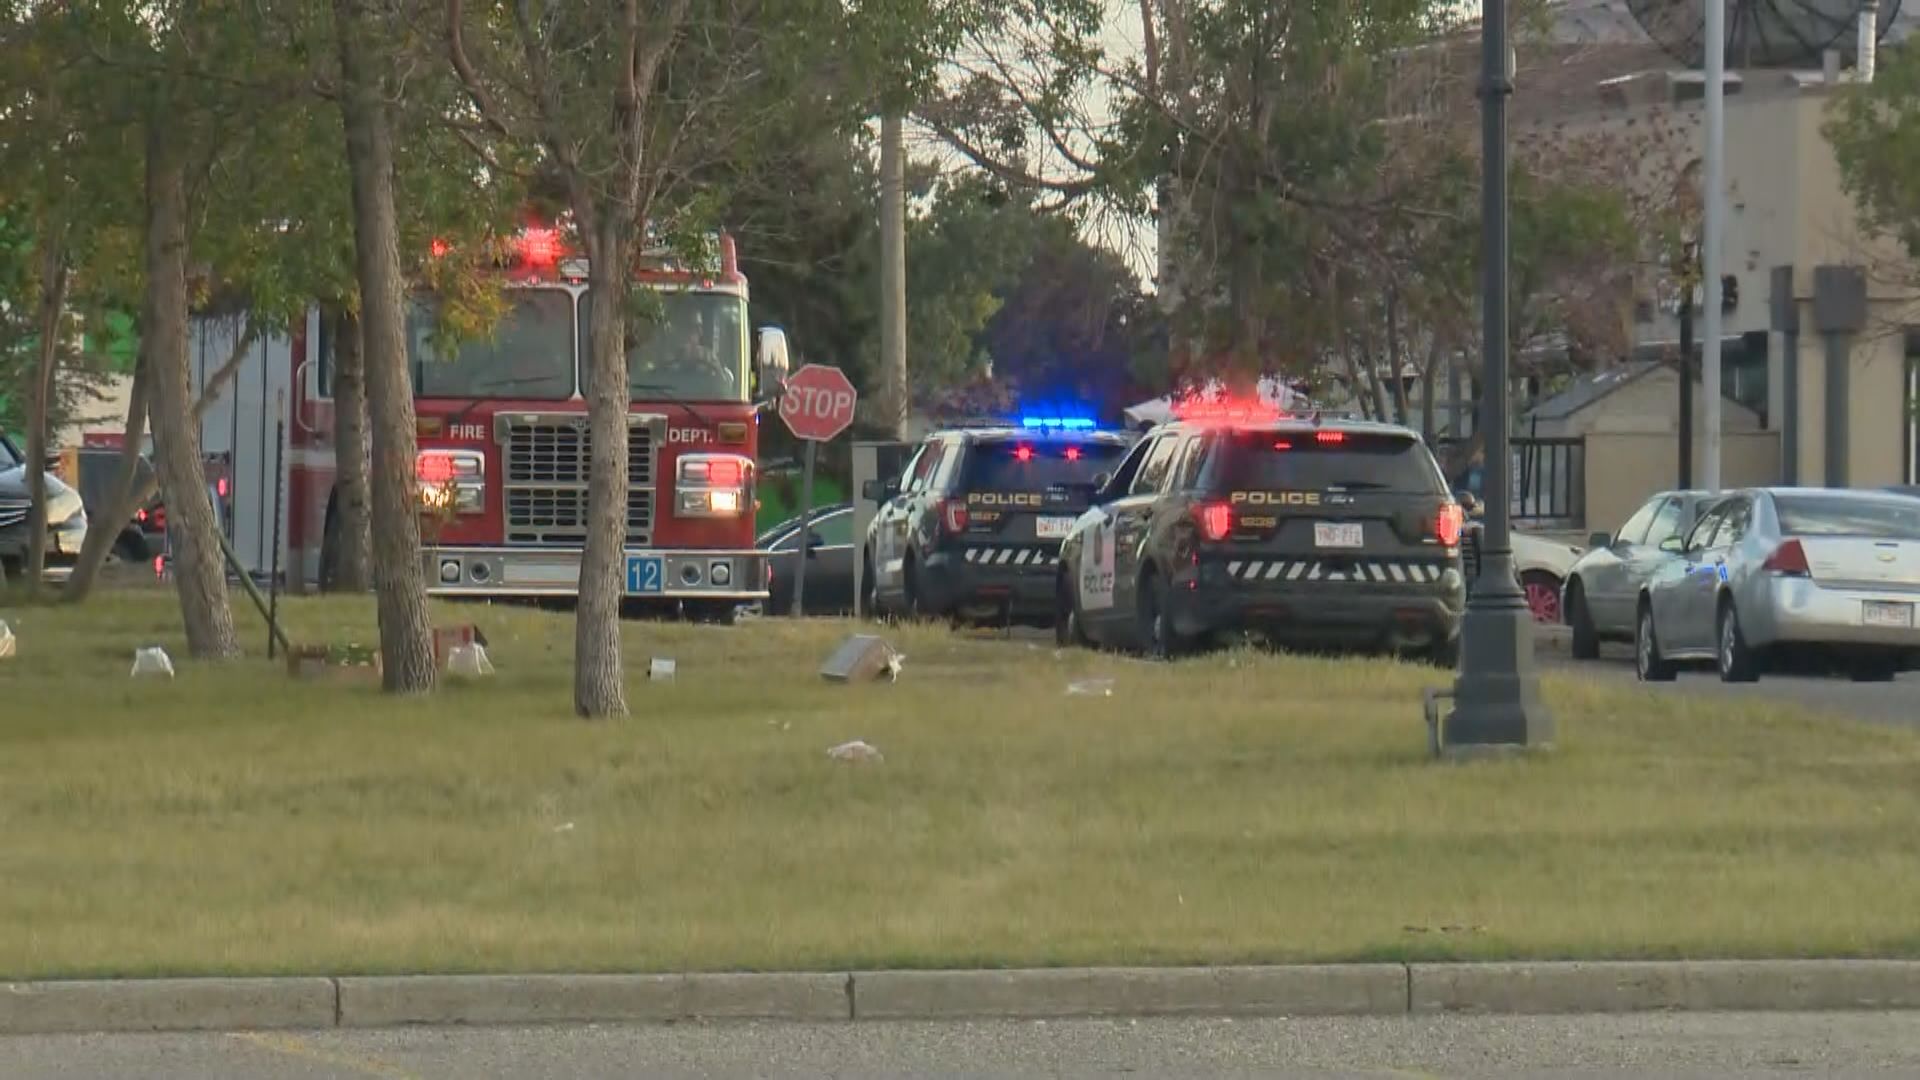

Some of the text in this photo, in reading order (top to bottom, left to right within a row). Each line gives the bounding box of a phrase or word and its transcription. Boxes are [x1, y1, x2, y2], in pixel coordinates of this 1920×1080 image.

[784, 385, 850, 418] STOP
[450, 425, 713, 443] FIRE DEPT.
[967, 493, 1041, 506] POLICE
[1231, 491, 1320, 505] POLICE
[632, 560, 658, 590] 12
